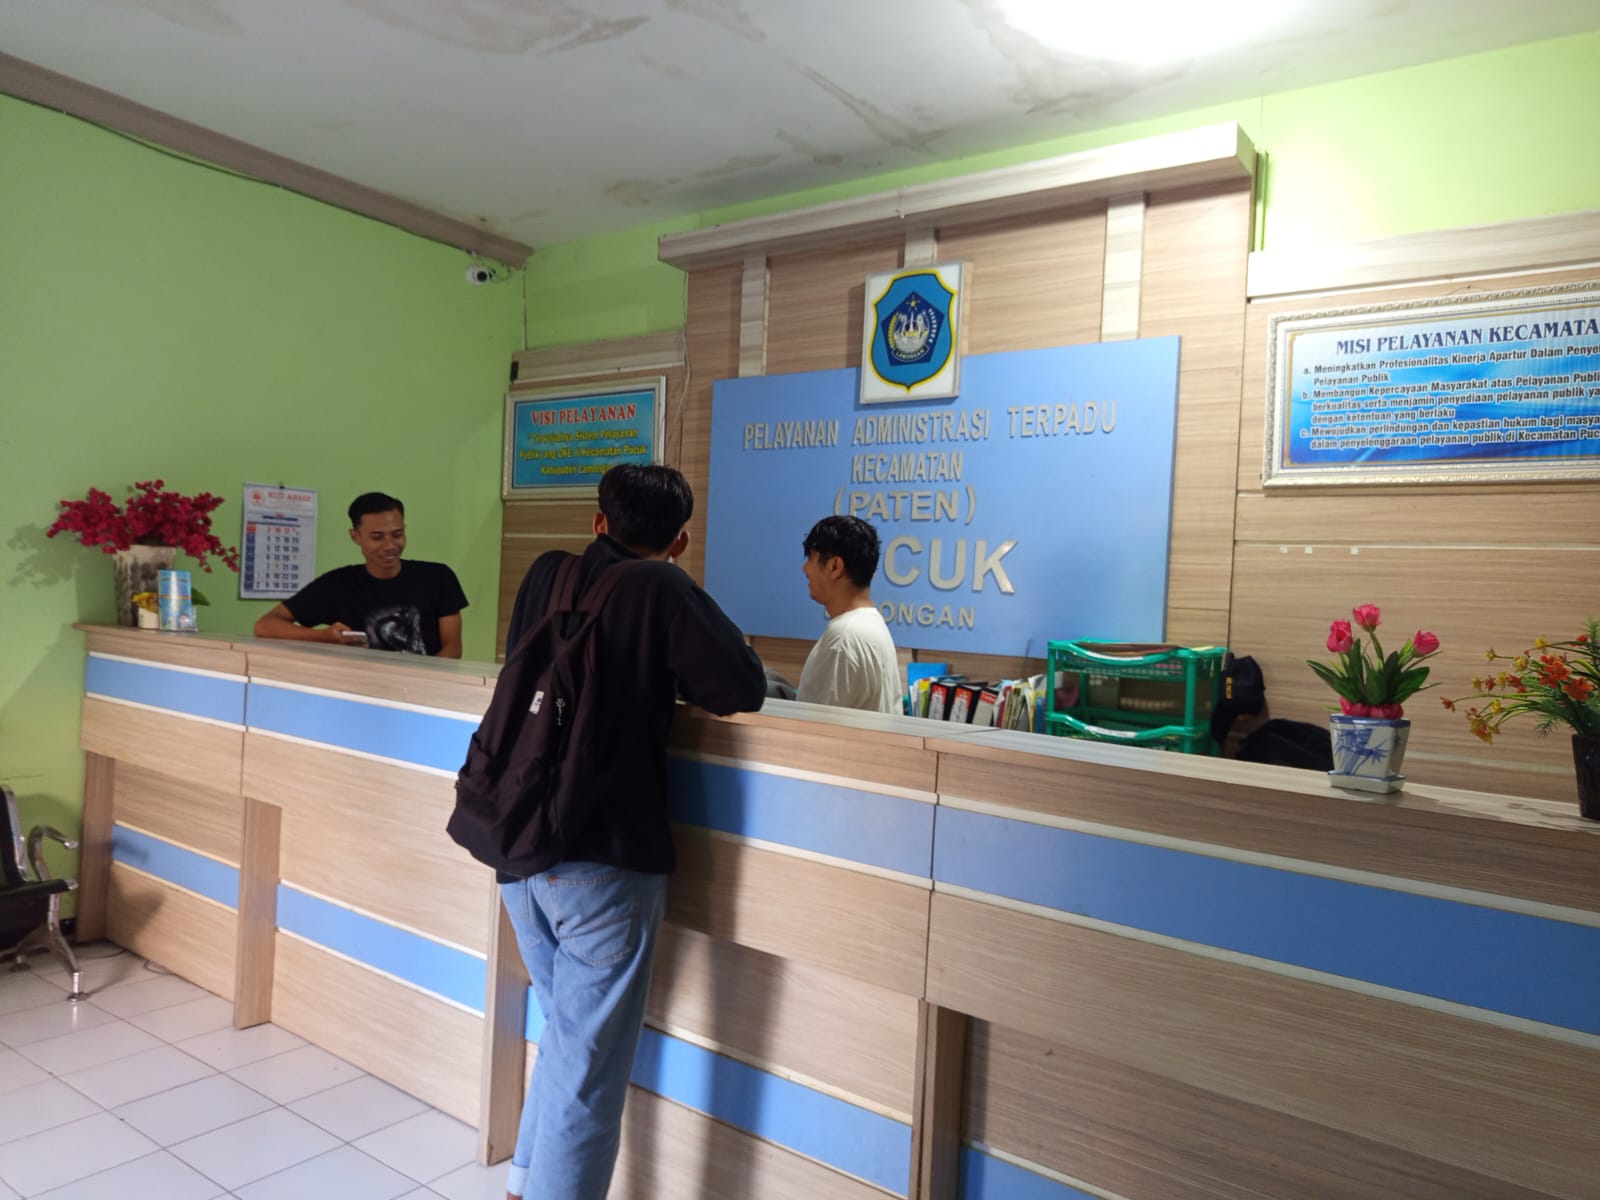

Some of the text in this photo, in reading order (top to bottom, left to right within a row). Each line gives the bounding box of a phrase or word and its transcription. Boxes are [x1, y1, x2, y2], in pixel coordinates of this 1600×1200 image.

[1336, 318, 1600, 355] MISI PELAYANAN KECAMATA
[1314, 361, 1376, 374] Meningkatkan
[1379, 356, 1449, 368] Profesionalitas
[1452, 352, 1486, 363] Kinerja
[1489, 350, 1527, 362] Apartur
[1530, 347, 1563, 358] Dalam
[1313, 373, 1390, 386] Pelayanan Publik
[1313, 387, 1366, 399] Membangun
[1369, 384, 1428, 396] Kepercayaan
[1431, 379, 1488, 391] Masyarakat
[1490, 379, 1513, 388] atas
[1516, 375, 1570, 387] Pelayanan
[1312, 400, 1361, 411] berkualitas
[1364, 399, 1387, 408] serta
[1390, 396, 1435, 407] menjamin
[1438, 392, 1493, 405] penyediaan
[1496, 390, 1549, 402] pelayanan
[1552, 386, 1585, 400] publik
[531, 402, 637, 425] VISI PELAYANAN
[743, 400, 1118, 450] PELAYANAN ADMINISTRASI TERPADU
[1311, 424, 1366, 436] Mewujudkan
[1369, 422, 1429, 434] perlindungan
[1432, 421, 1450, 431] dan
[1453, 418, 1500, 430] kepastian
[1503, 416, 1537, 427] hukum
[1541, 415, 1563, 426] bagi
[1312, 408, 1455, 424] dengan ketentuan yang berlaku
[1311, 439, 1338, 448] dalam
[1340, 436, 1417, 449] penyelenggaraan
[1420, 434, 1469, 446] pelayanan
[1472, 432, 1503, 446] publik
[1505, 431, 1515, 441] di
[1518, 429, 1576, 441] Kecamatan
[851, 451, 964, 484] KECAMATAN
[834, 484, 977, 526] (PATEN)
[873, 535, 1019, 595] CUK
